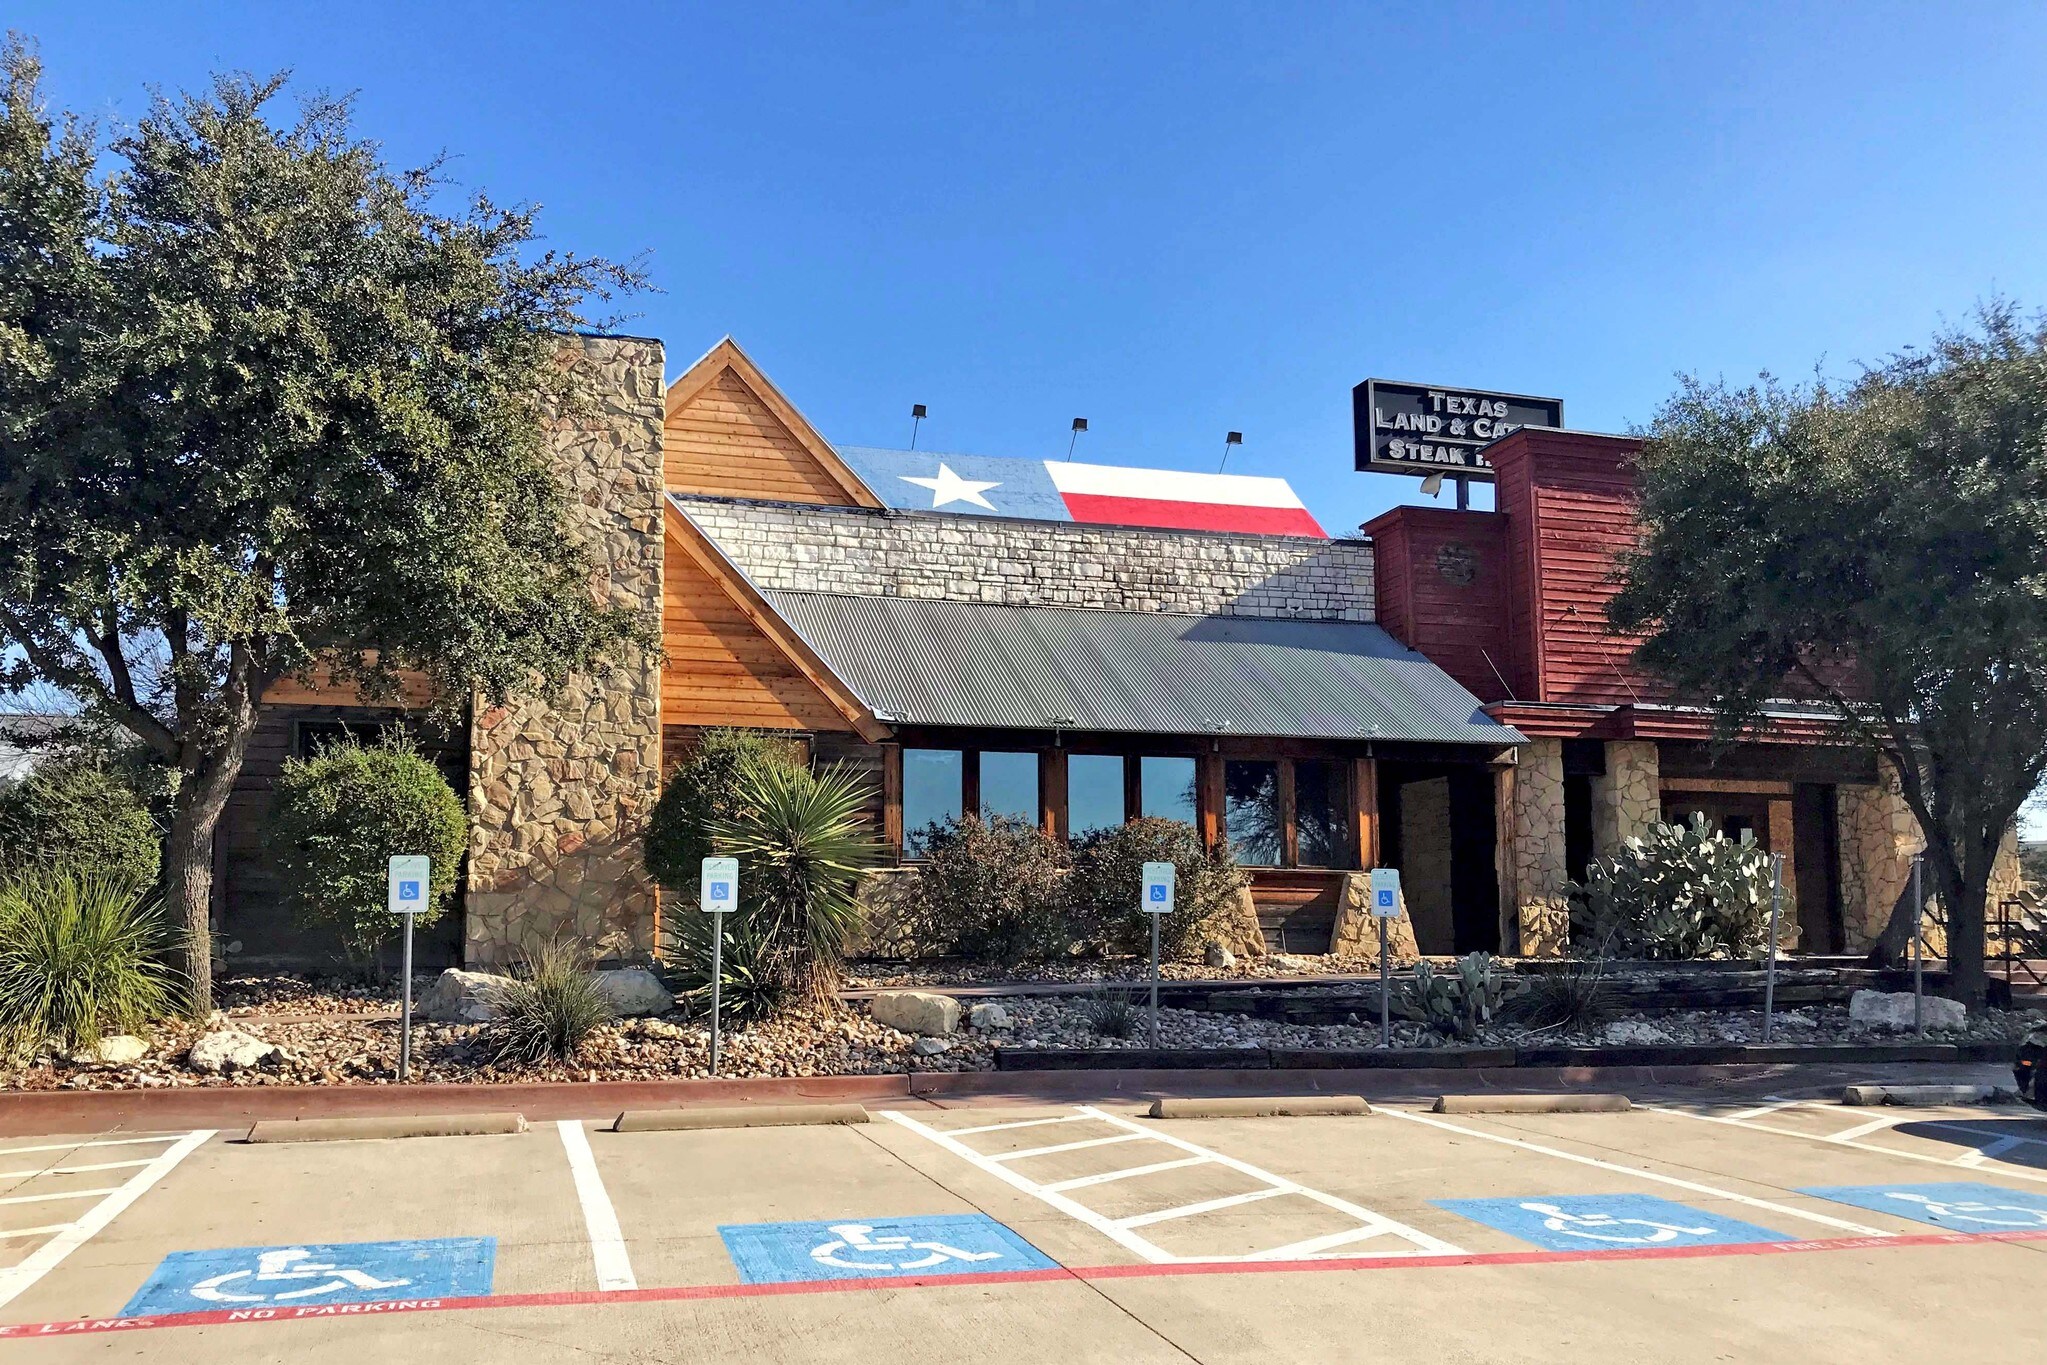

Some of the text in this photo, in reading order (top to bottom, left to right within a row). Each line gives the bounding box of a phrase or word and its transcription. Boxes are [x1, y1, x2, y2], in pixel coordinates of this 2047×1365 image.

[1428, 391, 1508, 417] TEXAS
[1375, 407, 1441, 433] LAND
[1449, 418, 1466, 436] &
[1388, 438, 1465, 465] STEAK
[706, 872, 733, 880] PARKING
[228, 1309, 276, 1320] NO
[295, 1300, 442, 1316] PARKING
